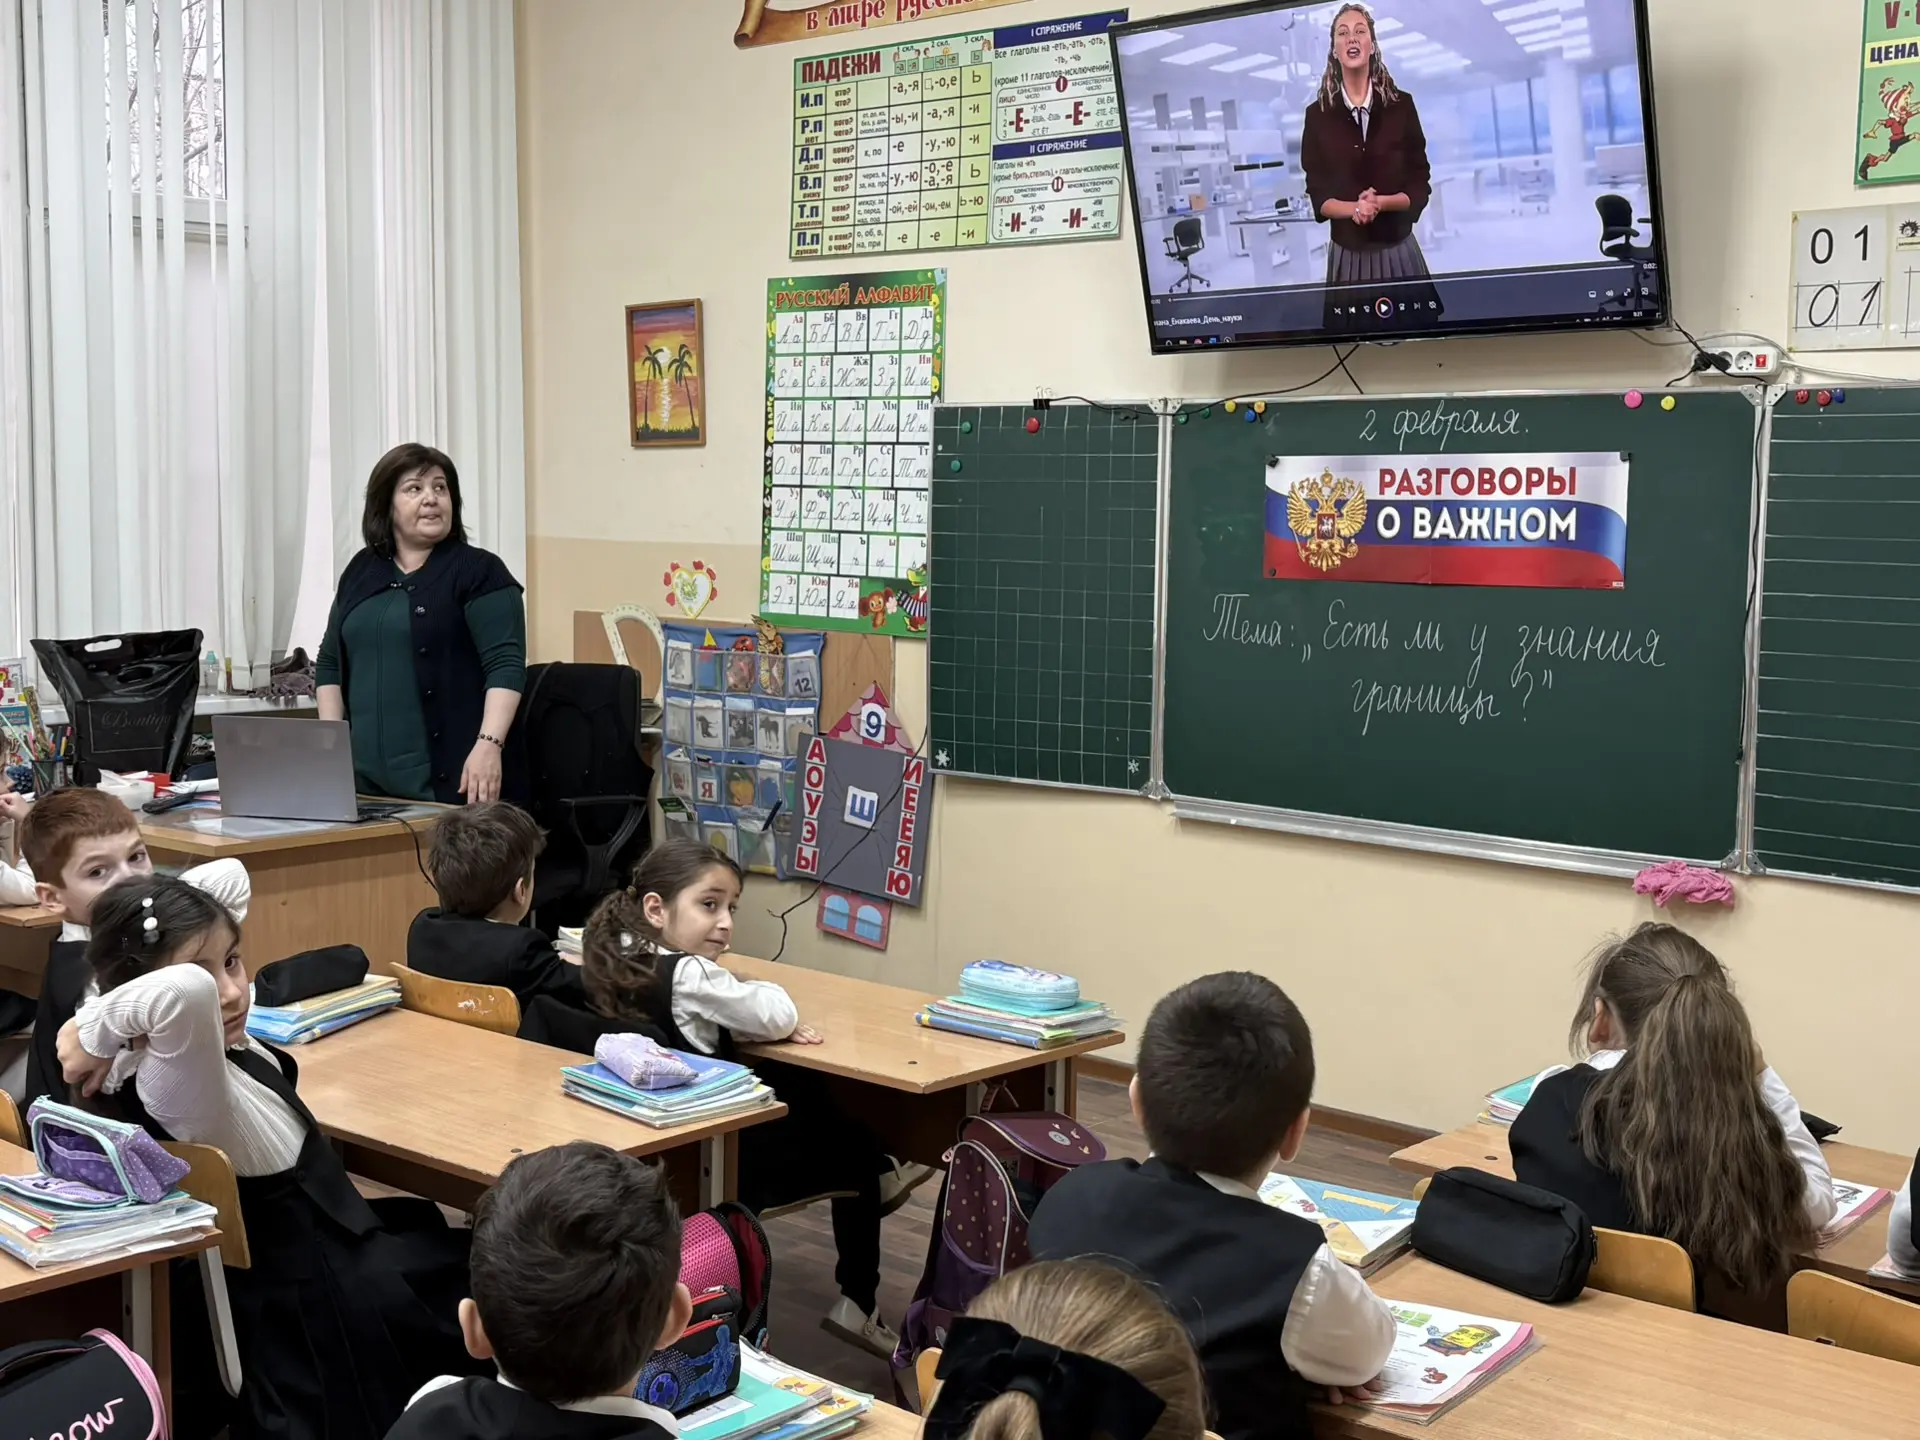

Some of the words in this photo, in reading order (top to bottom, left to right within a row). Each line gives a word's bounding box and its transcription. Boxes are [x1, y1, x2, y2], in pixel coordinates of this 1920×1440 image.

[806, 12, 818, 30] в
[828, 1, 884, 28] мире
[1035, 21, 1082, 35] СПРЯЖЕНИЕ
[994, 50, 1007, 59] Все
[1010, 45, 1040, 57] глаголы
[1870, 42, 1919, 63] ЦЕНА
[801, 51, 881, 83] ПАДЕЖИ
[994, 74, 1019, 87] (кроме
[1021, 73, 1029, 82] 11
[872, 148, 882, 157] по
[1037, 139, 1087, 152] СПРЯЖЕНИЕ
[994, 161, 1015, 170] Глаголы
[776, 282, 850, 308] РУССКИЙ
[854, 284, 935, 305] АЛФАВИТ
[820, 401, 832, 410] Кк
[1359, 409, 1378, 442] 2
[853, 446, 864, 457] Рр
[880, 446, 891, 455] Сс
[1378, 467, 1577, 497] РАЗГОВОРЫ
[1376, 506, 1401, 540] О
[1412, 506, 1577, 542] ВАЖНОМ
[848, 579, 859, 588] Яя
[1404, 620, 1444, 651] ли
[1467, 623, 1488, 688] у
[1510, 623, 1666, 689] знания
[795, 677, 813, 693] 12
[1351, 678, 1502, 736] границы
[865, 711, 881, 738] 9
[701, 782, 714, 798] Я
